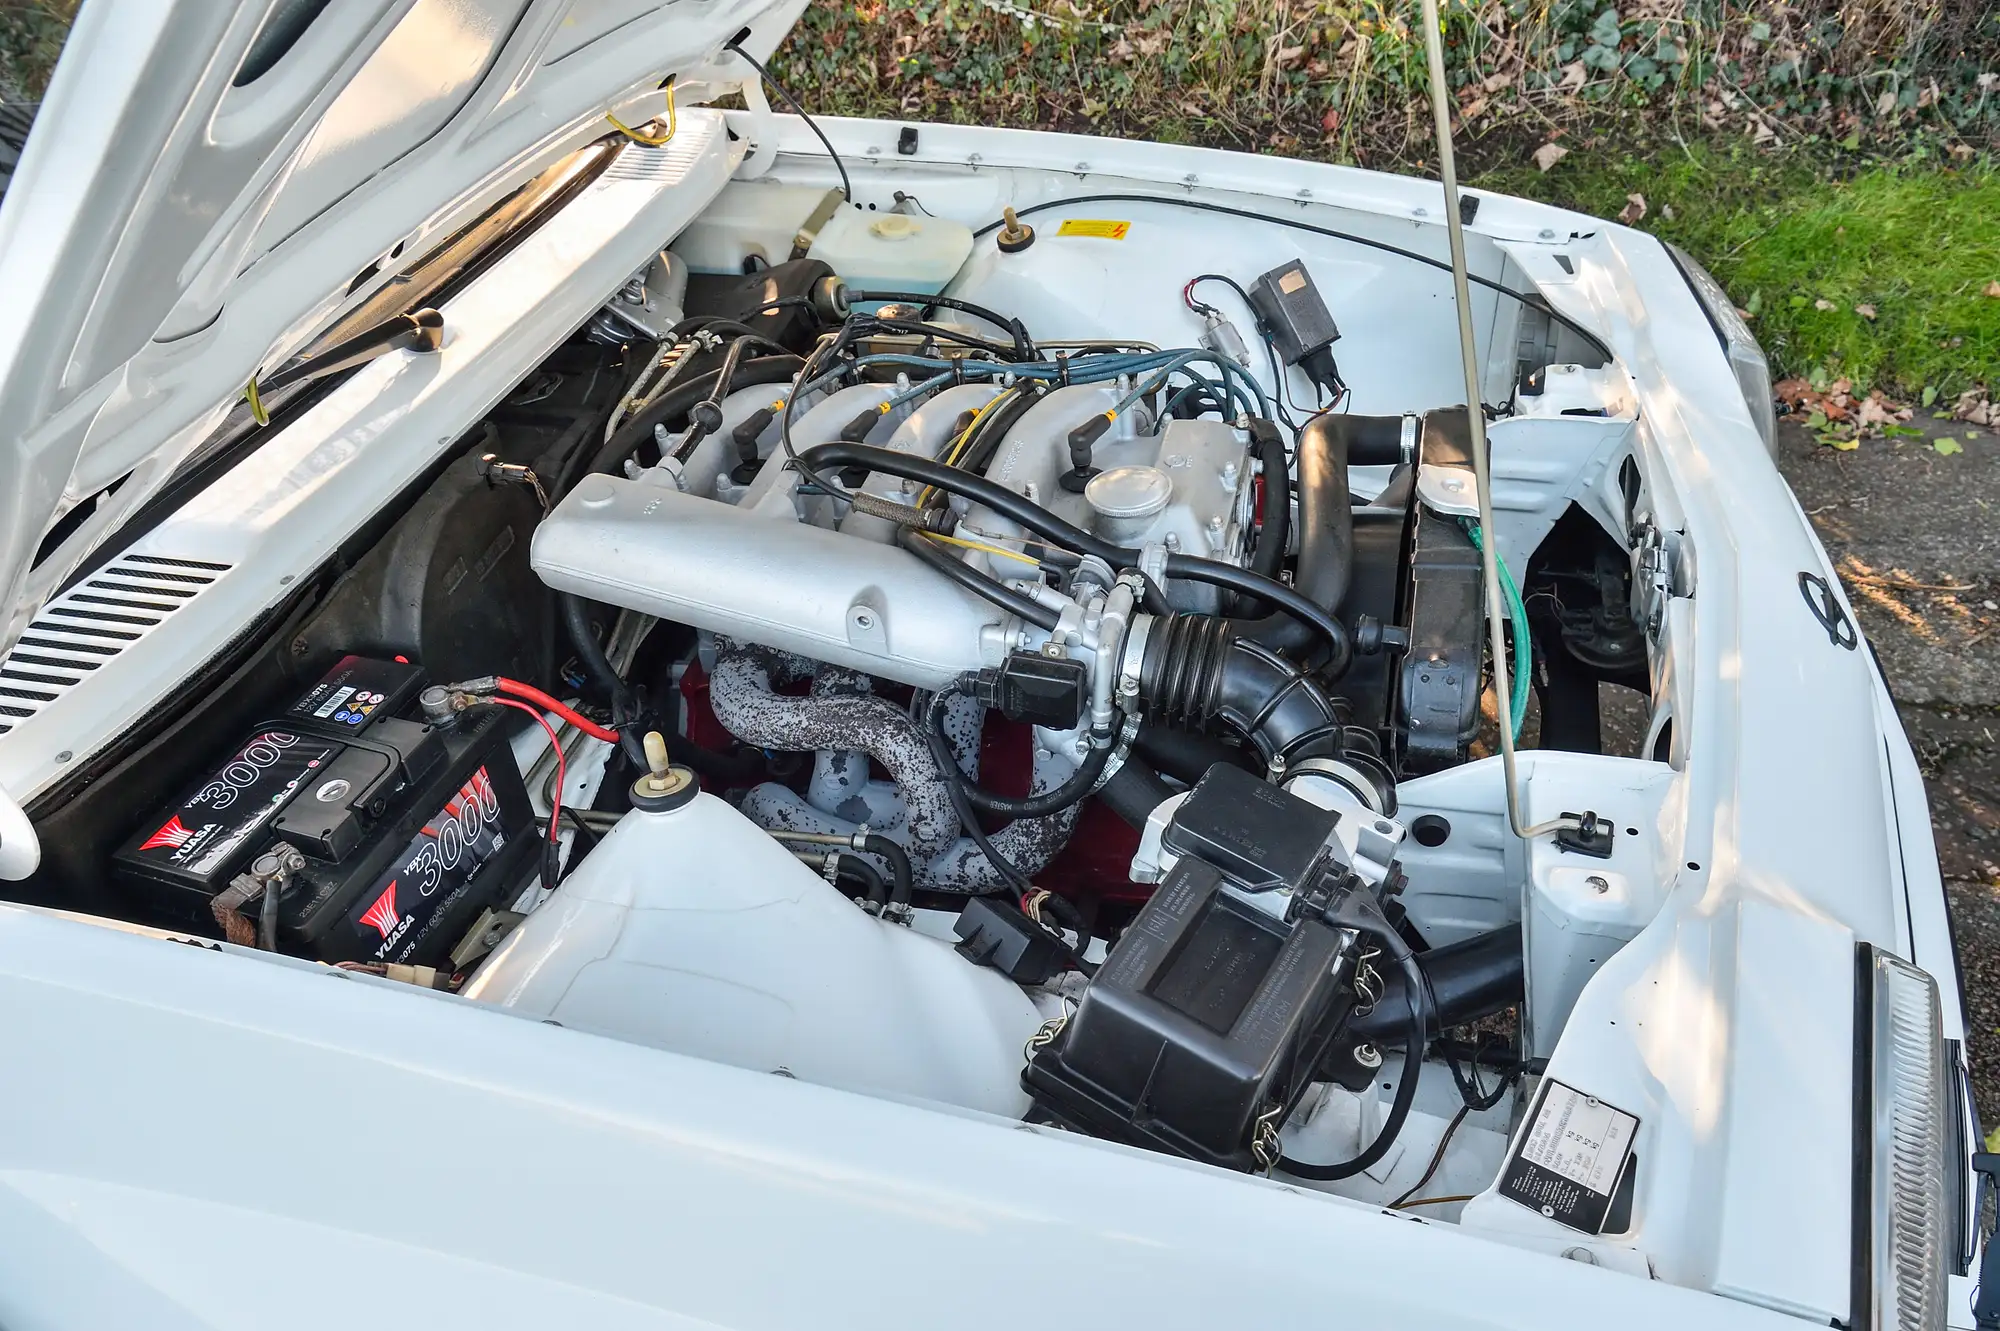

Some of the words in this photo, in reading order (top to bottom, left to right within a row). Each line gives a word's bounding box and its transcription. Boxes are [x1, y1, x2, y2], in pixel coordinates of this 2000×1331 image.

[184, 793, 205, 809] YBX
[989, 800, 1013, 812] MASTER
[170, 823, 217, 861] YUASA
[403, 855, 423, 877] YBX
[417, 926, 429, 940] 12V
[429, 907, 446, 927] 60Ah
[445, 888, 461, 909] 550A
[375, 914, 415, 959] YUASA
